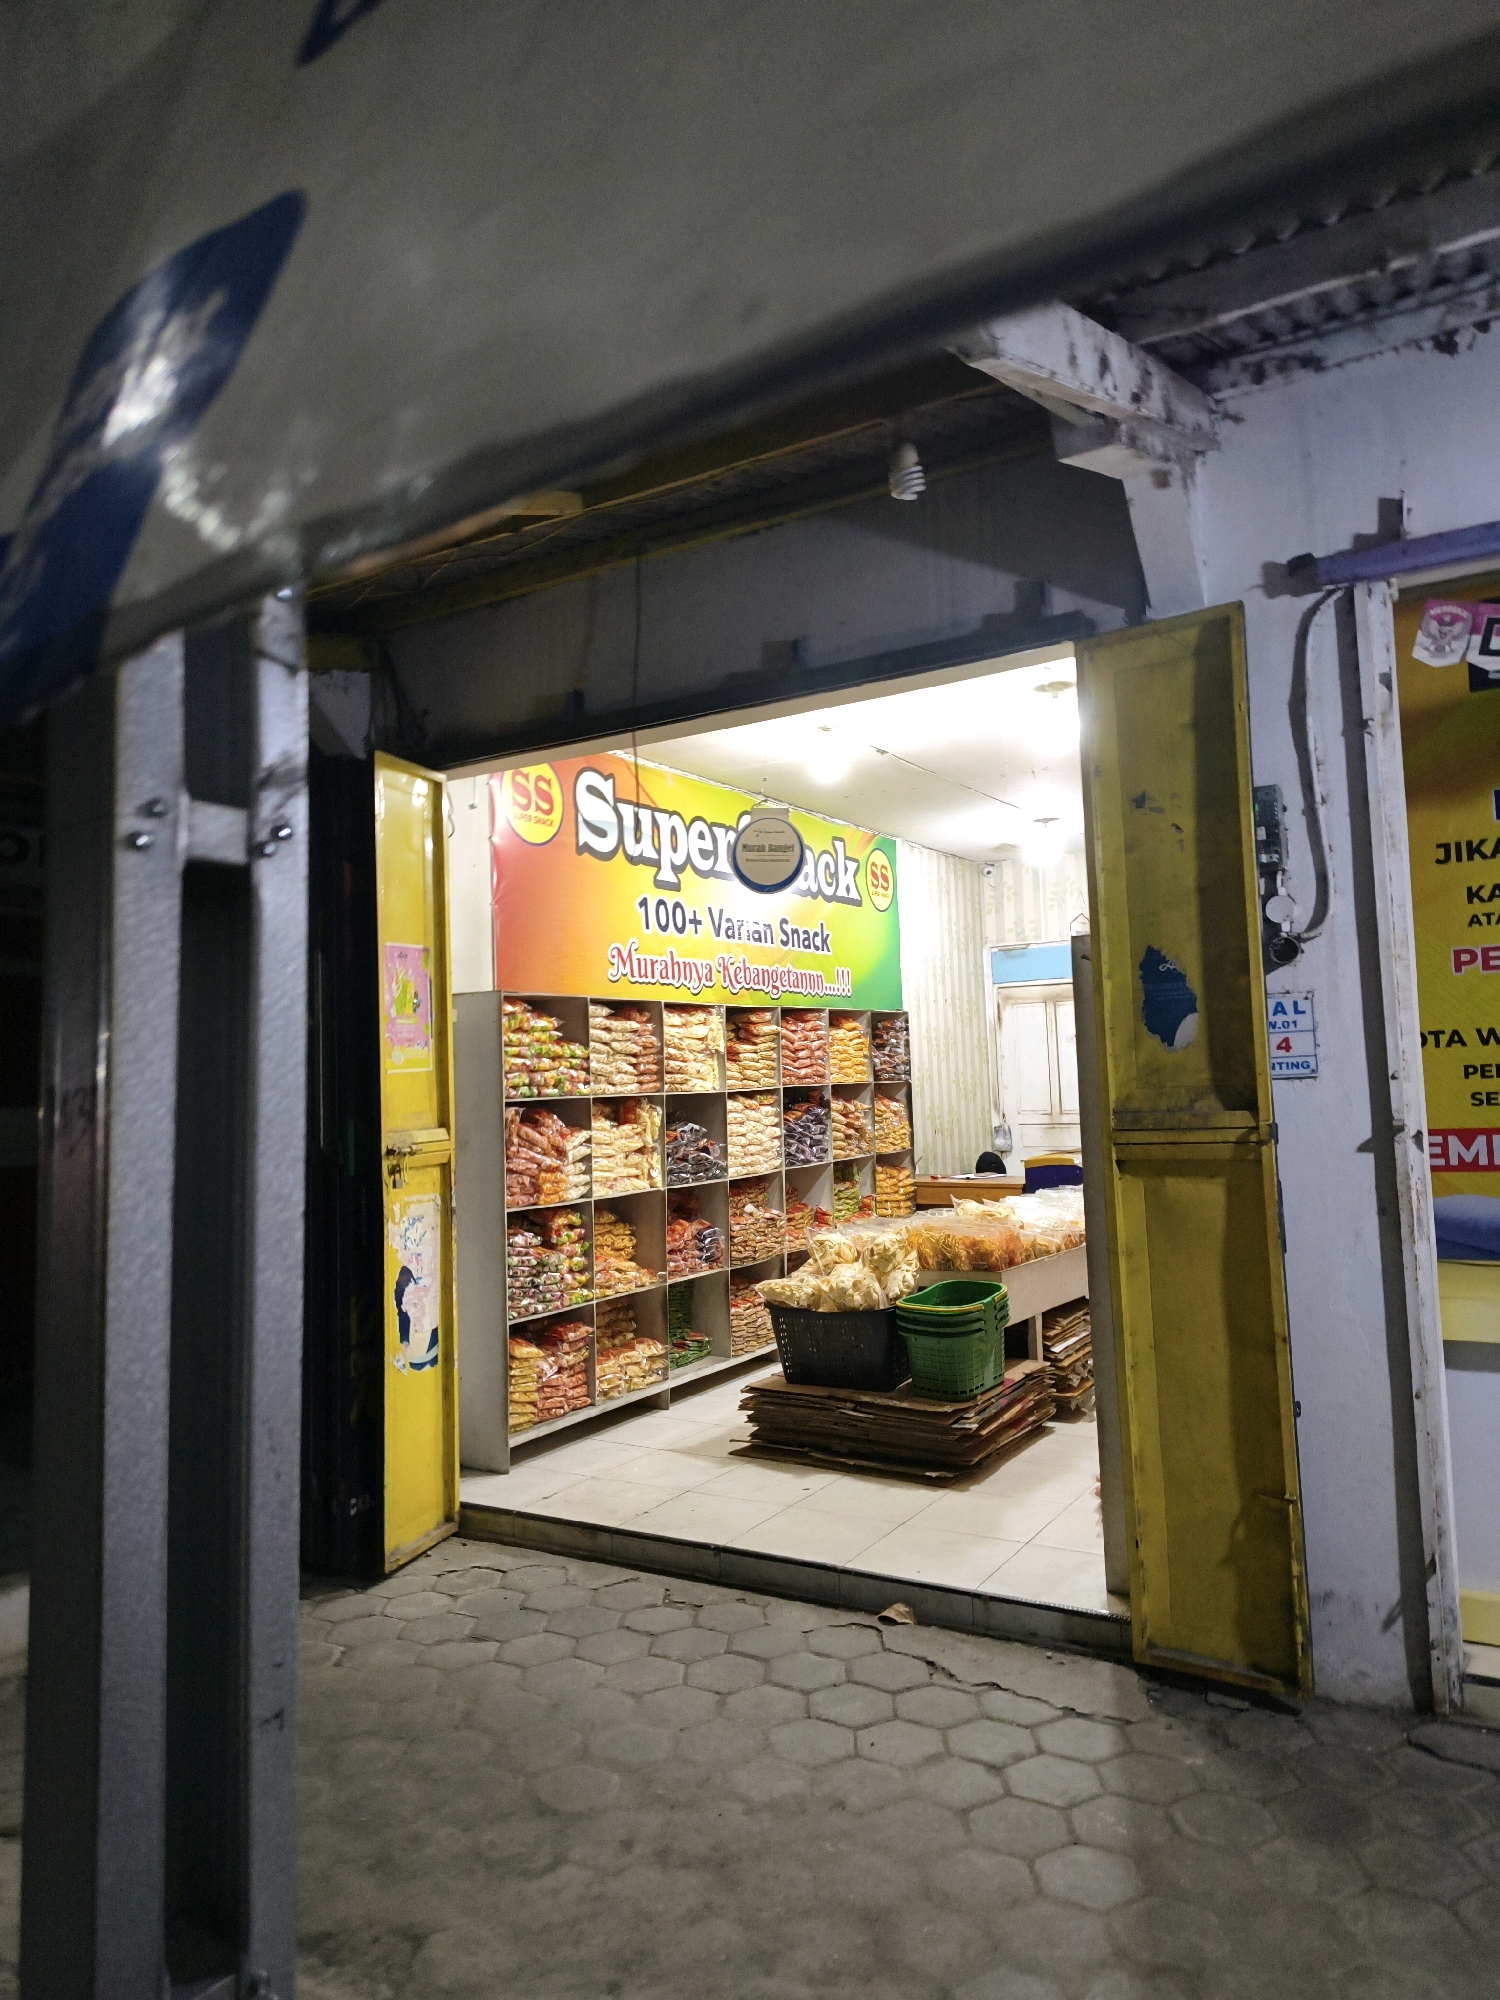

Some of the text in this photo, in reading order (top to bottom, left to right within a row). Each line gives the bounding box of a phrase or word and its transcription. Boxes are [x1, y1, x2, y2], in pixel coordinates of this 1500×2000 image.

[511, 769, 554, 816] SS
[575, 766, 739, 891] Super
[870, 862, 889, 891] SS
[638, 897, 831, 952] 100+ Varian Snack
[610, 941, 713, 990] Murahnya
[1276, 1036, 1292, 1053] 4
